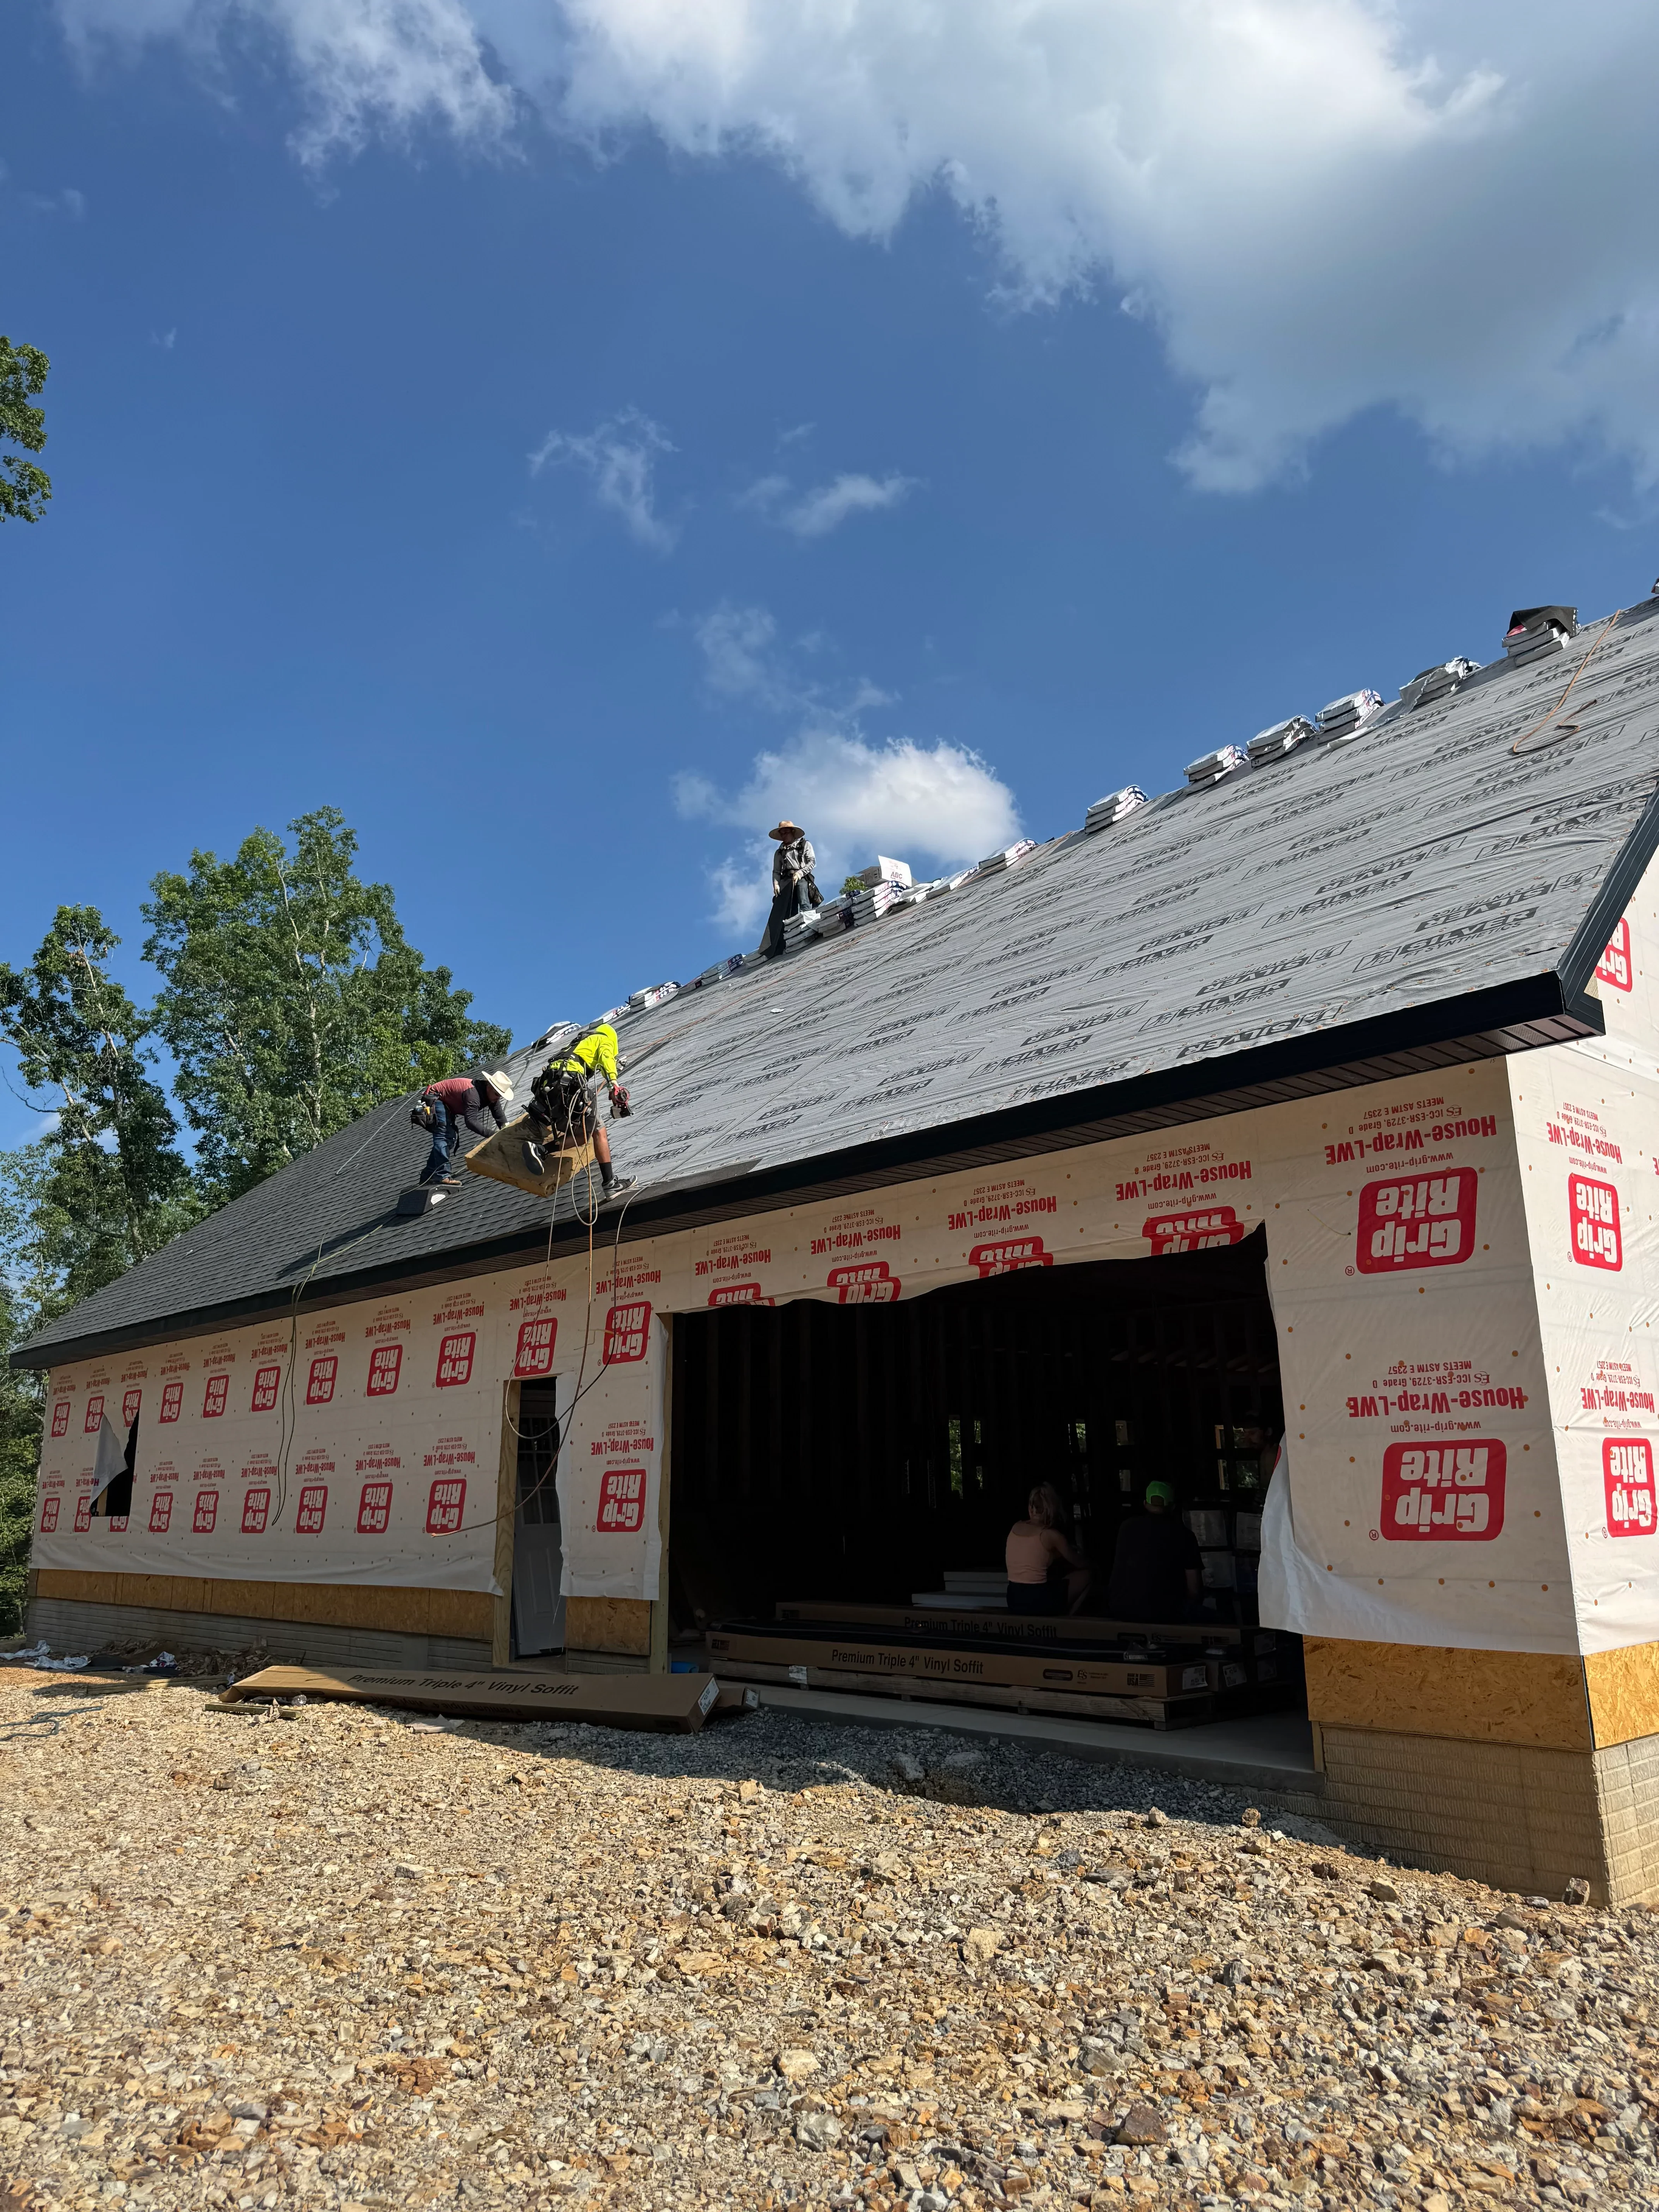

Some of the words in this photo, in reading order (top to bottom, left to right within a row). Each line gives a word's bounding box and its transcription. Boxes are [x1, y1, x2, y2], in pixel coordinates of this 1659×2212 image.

[1305, 875, 1405, 910] SILVER
[1424, 888, 1544, 928] SILVER
[1407, 911, 1529, 951] SILVER
[1425, 921, 1523, 952] SYNTHETICS
[1125, 938, 1206, 967] SILVER
[1203, 960, 1303, 993] SILVER
[1597, 950, 1628, 985] Gri
[1184, 981, 1284, 1014] SILVER
[1197, 991, 1275, 1016] SYNTHETICS
[1185, 1022, 1291, 1055] SILVER
[1006, 1037, 1087, 1063] SILVER
[1391, 1103, 1413, 1114] ASTM
[1416, 1096, 1444, 1109] MEETS
[1363, 1109, 1382, 1119] 2357
[1384, 1109, 1443, 1126] ICC-ESR-3729,
[1348, 1126, 1353, 1134] D
[1358, 1121, 1381, 1132] Grade
[1324, 1115, 1496, 1165] House-Wrap-LWE
[1546, 1121, 1622, 1164] House-Wrap-LWE
[1146, 1152, 1161, 1161] 2357
[1168, 1148, 1186, 1158] ASTM
[1366, 1152, 1453, 1173] www.grip-rite.com
[1142, 1163, 1161, 1173] Grade
[973, 1187, 985, 1195] 2357
[991, 1183, 1005, 1192] ASTM
[1007, 1179, 1025, 1188] MEETS
[1115, 1160, 1251, 1201] House-Wrap-LWE
[970, 1196, 985, 1205] Grade
[1147, 1192, 1217, 1209] www.grip-rite.com
[1375, 1176, 1460, 1219] Rite
[1576, 1182, 1613, 1224] Rite
[947, 1195, 1056, 1231] House-Wrap-LWE
[810, 1224, 900, 1255] House-Wrap-LWE
[973, 1224, 1029, 1238] www.grip-rite.com
[1370, 1219, 1461, 1262] Grip
[1577, 1216, 1617, 1264] Grip
[695, 1249, 771, 1276] House-Wrap-LWE
[596, 1269, 661, 1295] House-Wrap-LWE
[509, 1288, 566, 1311] House-Wrap-LWE
[433, 1305, 484, 1325] House-Wrap-LWE
[611, 1306, 645, 1332] Rite
[365, 1319, 410, 1338] House-Wrap-LWE
[522, 1322, 552, 1346] Rite
[251, 1343, 288, 1359] House-Wrap-LWE
[305, 1331, 345, 1350] House-Wrap-LWE
[444, 1336, 471, 1358] Rite
[608, 1332, 643, 1358] Grip
[313, 1359, 335, 1379] Rite
[374, 1348, 399, 1369] Rite
[519, 1346, 550, 1371] Grip
[1409, 1365, 1415, 1373] E
[1417, 1363, 1440, 1372] ASTM
[1443, 1361, 1472, 1371] MEETS
[258, 1369, 278, 1388] Rite
[370, 1369, 396, 1391] Grip
[440, 1358, 469, 1382] Grip
[1388, 1365, 1407, 1374] 2357
[1409, 1374, 1471, 1384] ICC-ESR-3729,
[208, 1377, 227, 1396] Rite
[309, 1379, 332, 1400] Grip
[1372, 1380, 1377, 1389] D
[1383, 1378, 1407, 1388] Grade
[205, 1395, 224, 1414] Grip
[254, 1388, 275, 1408] Grip
[1347, 1387, 1524, 1418] House-Wrap-LWE
[1580, 1385, 1656, 1413] House-Wrap-LWE
[1390, 1420, 1481, 1432] www.grip-rite.com
[295, 1461, 335, 1475] House-Wrap-LWE
[355, 1456, 401, 1472] House-Wrap-LWE
[423, 1451, 476, 1467] House-Wrap-LWE
[1400, 1447, 1487, 1487] Rite
[1610, 1445, 1647, 1483] Rite
[240, 1465, 277, 1478] House-Wrap-LWE
[364, 1486, 389, 1507] Rite
[434, 1483, 462, 1504] Rite
[606, 1474, 641, 1499] Rite
[198, 1494, 216, 1511] Rite
[247, 1491, 268, 1510] Rite
[303, 1489, 325, 1508] Rite
[1611, 1482, 1652, 1528] Grip
[195, 1510, 214, 1530] Grip
[244, 1509, 265, 1530] Grip
[299, 1508, 322, 1530] Grip
[361, 1506, 386, 1529] Grip
[430, 1504, 459, 1529] Grip
[602, 1498, 639, 1527] Grip
[1395, 1487, 1489, 1532] Grip
[982, 1621, 992, 1632] 4"
[832, 1649, 874, 1664] Premium
[878, 1653, 906, 1669] Triple
[909, 1656, 919, 1668] 4"
[924, 1656, 950, 1673] Vinyl
[954, 1659, 983, 1674] Soffit
[347, 1675, 415, 1685] Premium
[418, 1678, 462, 1689] Triple
[489, 1681, 531, 1693] Vinyl
[531, 1683, 579, 1695] Soffit
[1127, 1677, 1139, 1686] USA
